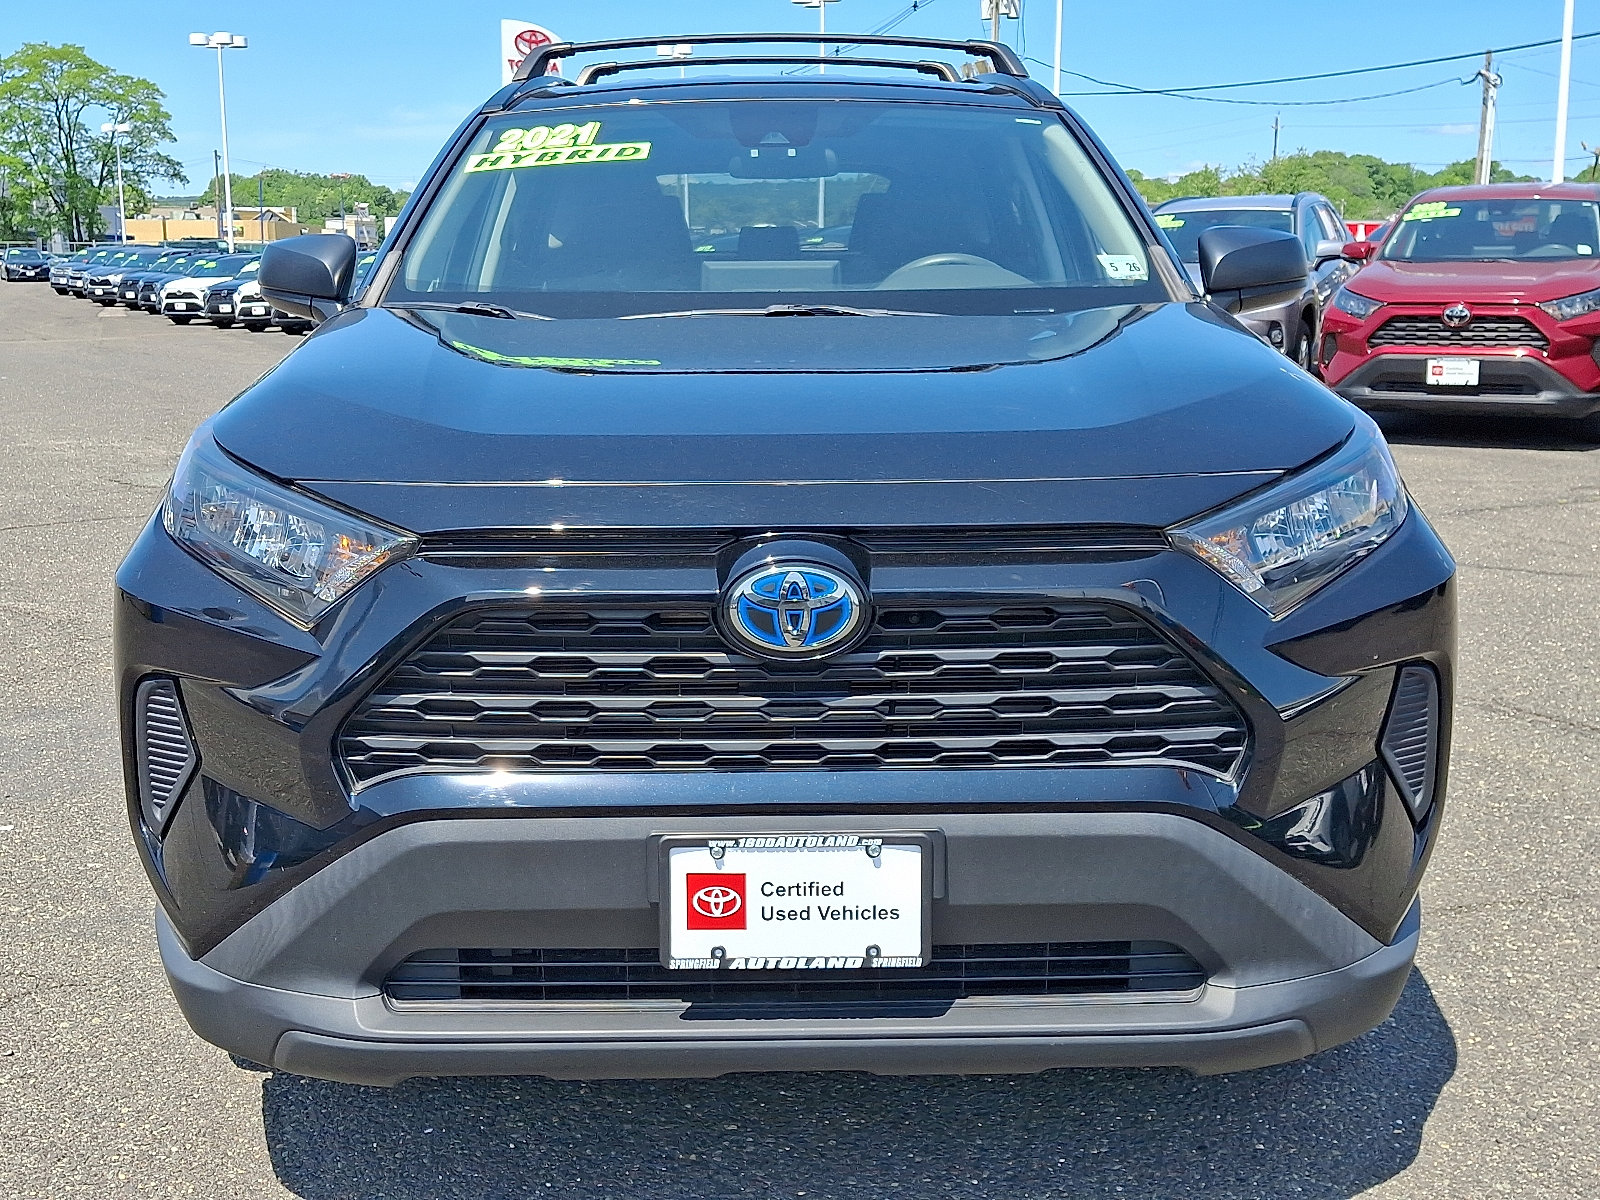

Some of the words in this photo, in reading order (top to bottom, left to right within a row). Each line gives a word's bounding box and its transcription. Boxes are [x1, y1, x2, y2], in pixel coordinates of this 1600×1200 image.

[507, 59, 560, 73] TOA
[493, 121, 602, 153] 2021
[473, 146, 642, 169] HYBRID
[1109, 262, 1119, 272] 5
[1126, 262, 1141, 272] 26
[708, 834, 883, 848] www.1800AUTOLAND.com
[760, 881, 845, 897] Certified
[761, 905, 811, 921] Used
[818, 904, 900, 921] Vehicles
[669, 957, 721, 970] SPRINGFIELD
[729, 956, 864, 970] AUTOLAND
[871, 956, 924, 969] SPRINGFIELD
